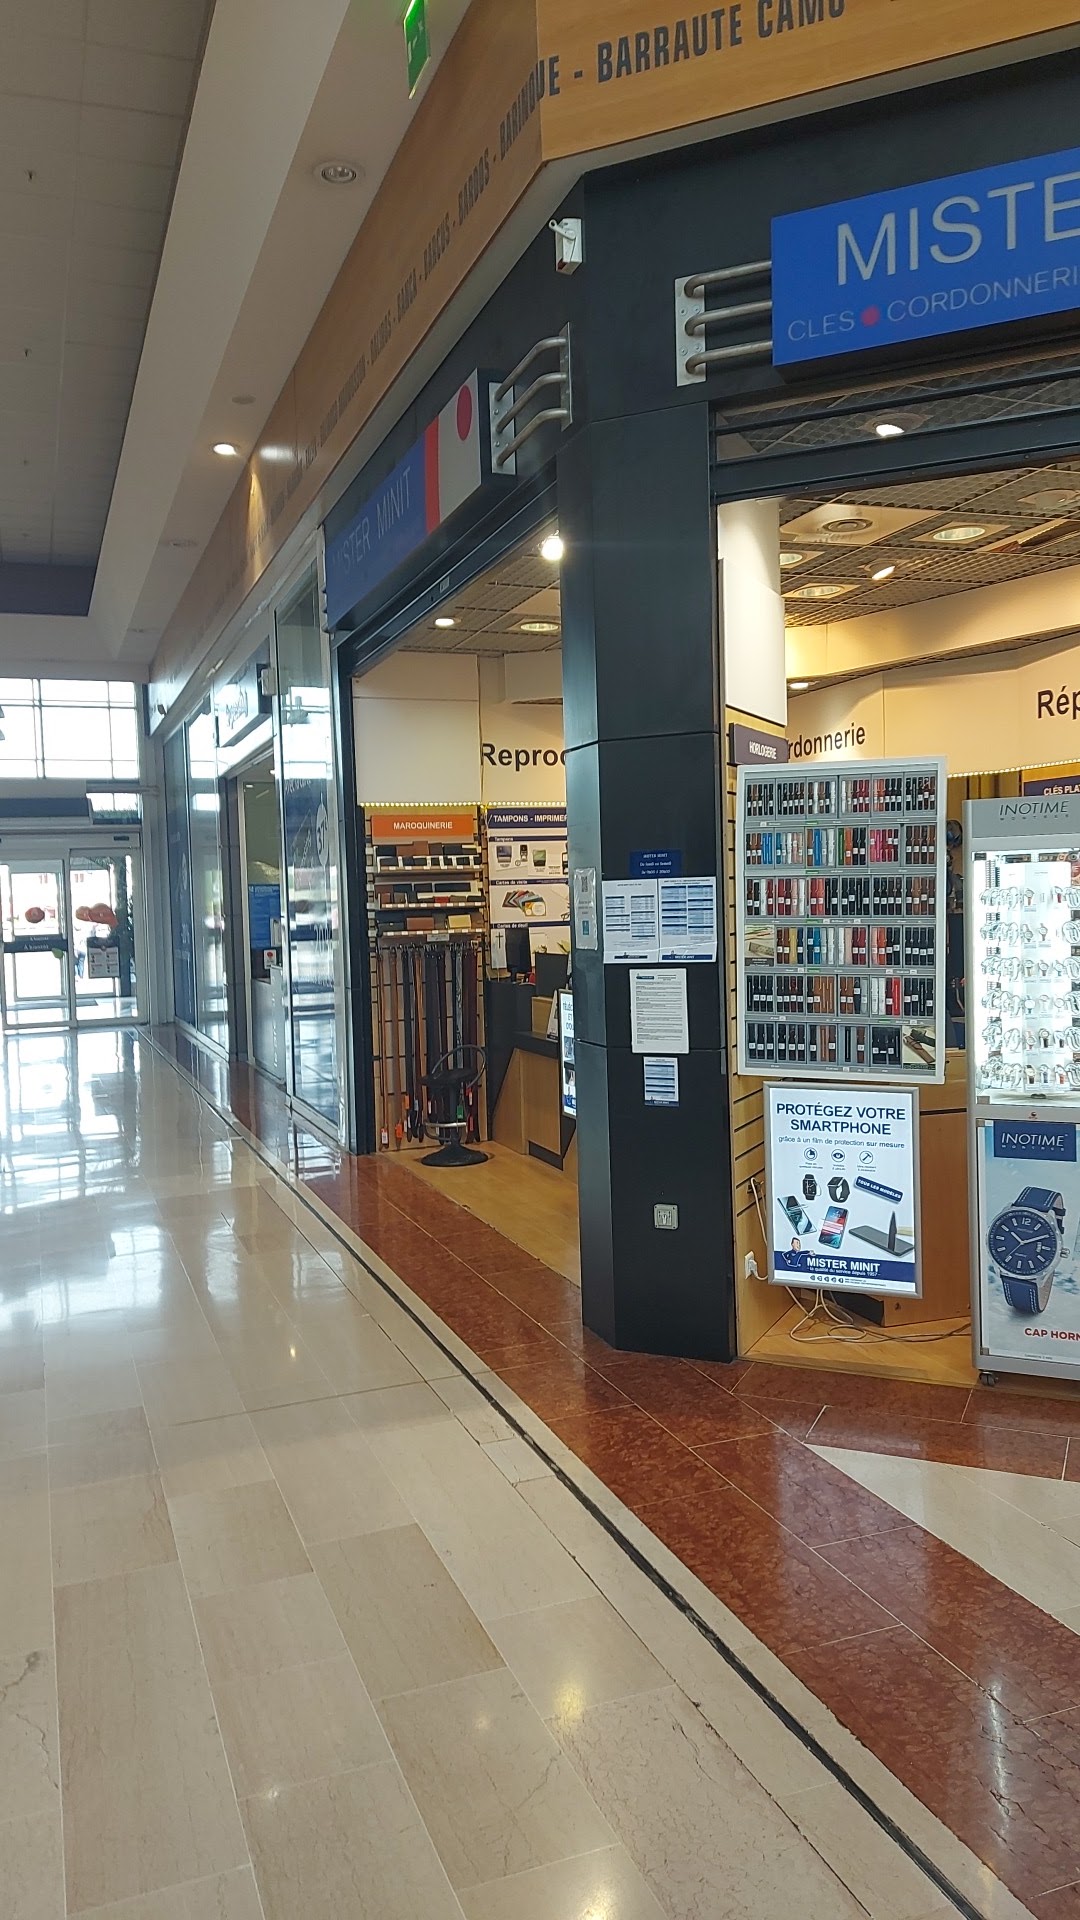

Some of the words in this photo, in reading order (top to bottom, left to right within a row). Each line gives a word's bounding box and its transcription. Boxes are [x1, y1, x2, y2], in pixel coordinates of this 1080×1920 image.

[597, 4, 743, 83] BARRAUTE
[837, 171, 1080, 286] MISTE
[788, 310, 855, 341] CLES
[887, 265, 1078, 322] CORDONNERI
[376, 466, 411, 539] MINIT
[749, 741, 777, 760] HORLOGERIE
[1044, 785, 1063, 796] CLÉS
[1000, 801, 1069, 815] INOTIME
[393, 821, 453, 830] MAROQUINERIE
[493, 814, 529, 823] TAMPONS
[776, 1101, 853, 1118] PROTÉGEZ
[856, 1107, 906, 1120] VOTRE
[790, 1119, 892, 1135] SMARTPHONE
[778, 1135, 796, 1143] grâce
[834, 1138, 865, 1147] protection
[1001, 1133, 1065, 1147] INOTIME
[807, 1257, 848, 1270] MISTER
[850, 1261, 880, 1272] MINIT
[1024, 1328, 1048, 1338] CAP
